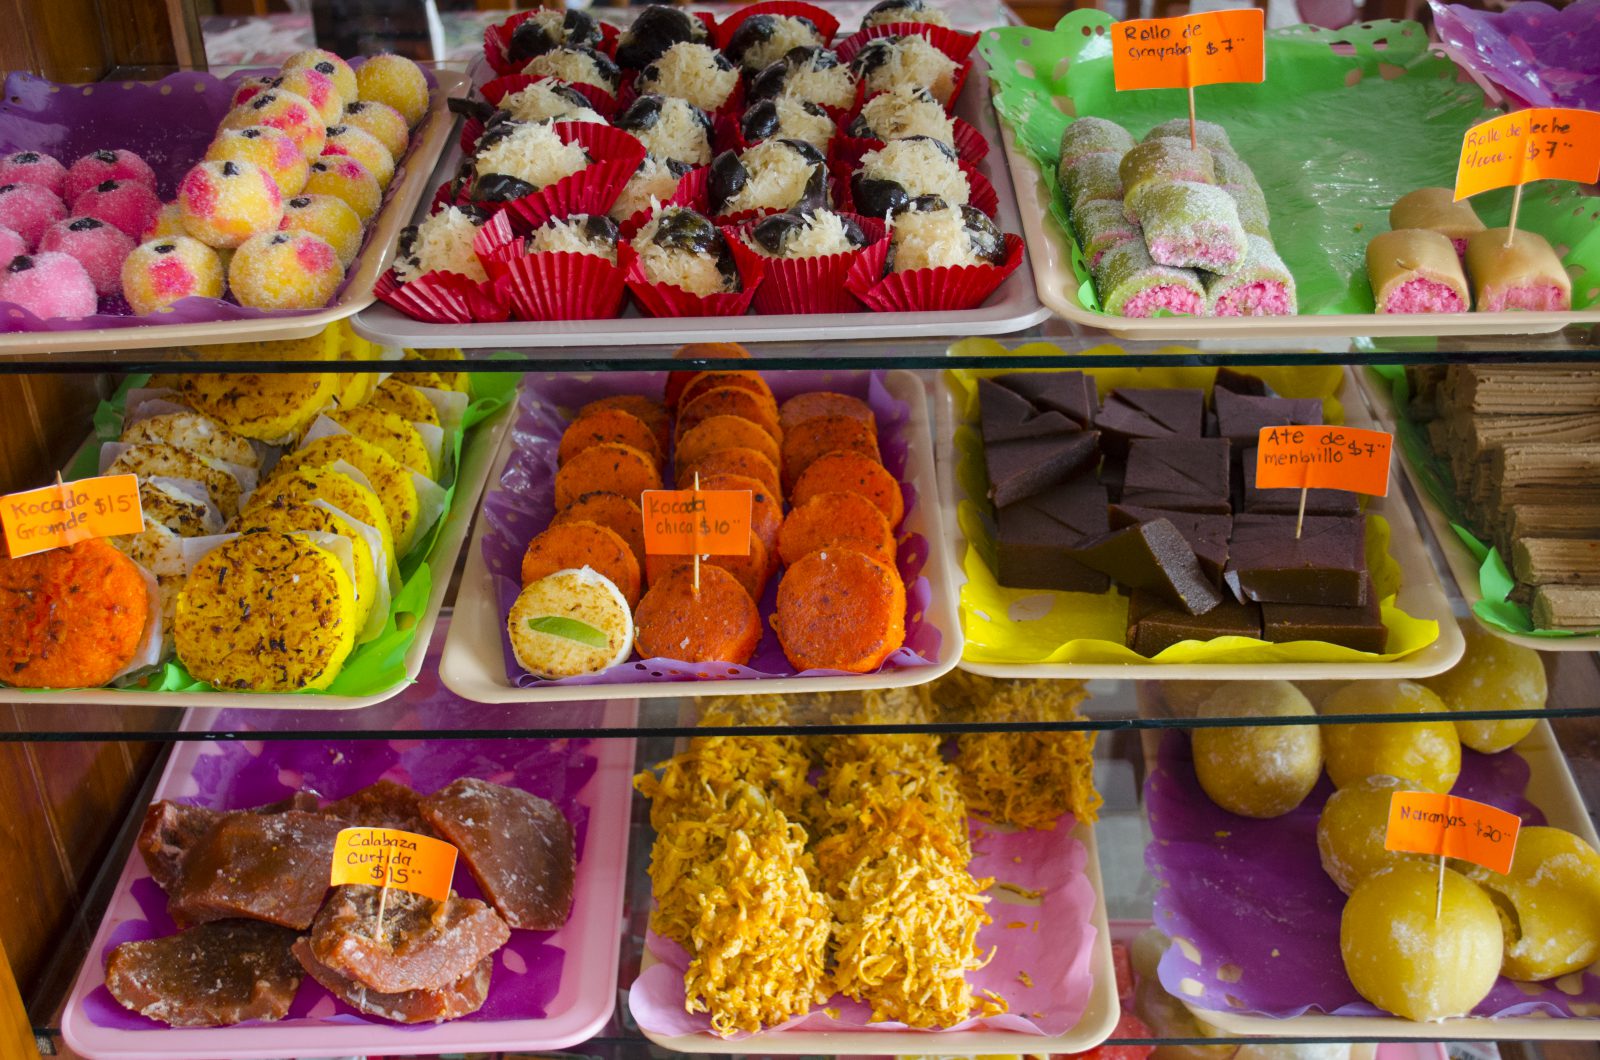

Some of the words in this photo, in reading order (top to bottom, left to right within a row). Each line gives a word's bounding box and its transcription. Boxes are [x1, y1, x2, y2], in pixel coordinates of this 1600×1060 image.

[1124, 25, 1170, 41] Rollo
[1182, 24, 1202, 39] de
[1530, 117, 1571, 134] leche
[1268, 429, 1304, 445] Ate
[1320, 432, 1346, 446] de
[1401, 806, 1466, 829] Naranjas
[348, 831, 417, 851] Calabaza
[347, 849, 411, 866] Curtida
